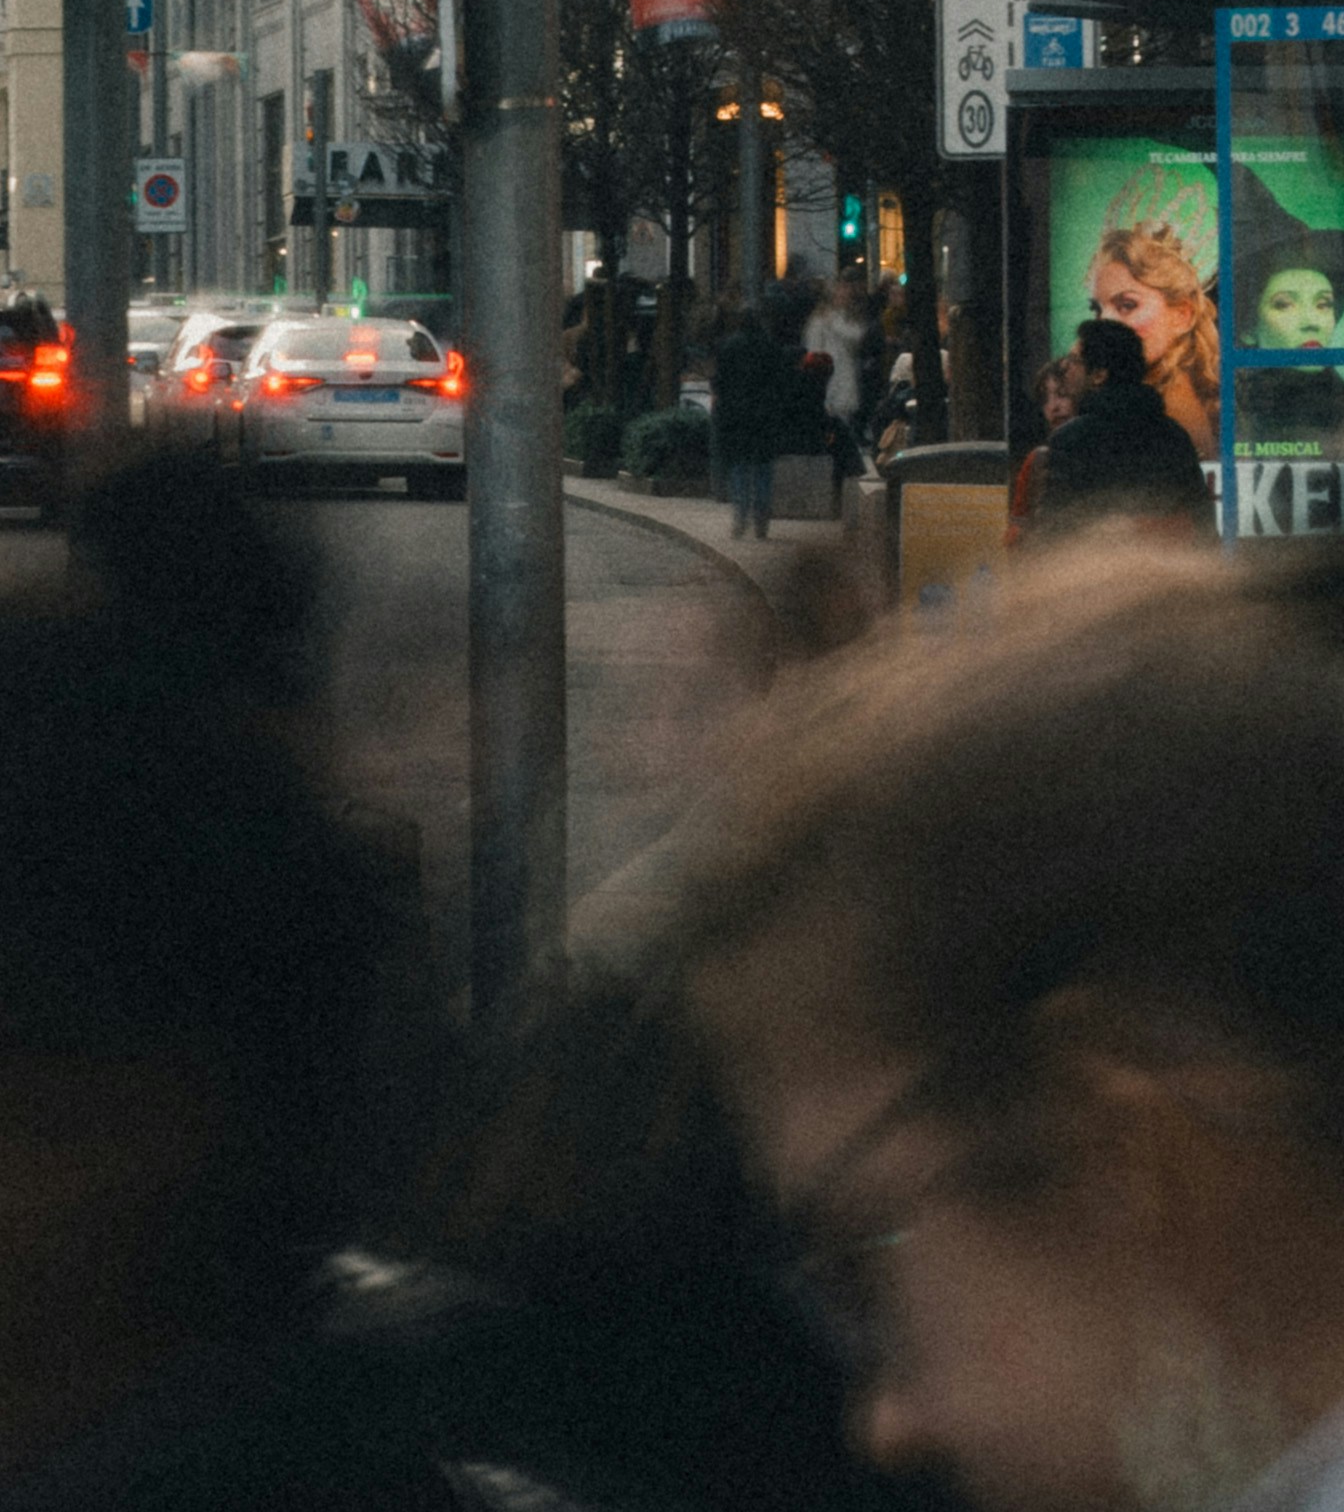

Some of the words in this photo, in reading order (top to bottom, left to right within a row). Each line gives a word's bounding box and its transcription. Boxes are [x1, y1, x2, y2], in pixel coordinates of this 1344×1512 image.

[1230, 13, 1271, 38] 002
[1285, 12, 1300, 37] 3
[965, 104, 986, 135] 30
[1256, 151, 1307, 163] SIEMPRE
[1233, 442, 1252, 456] EL
[1255, 441, 1323, 457] MUSICAL
